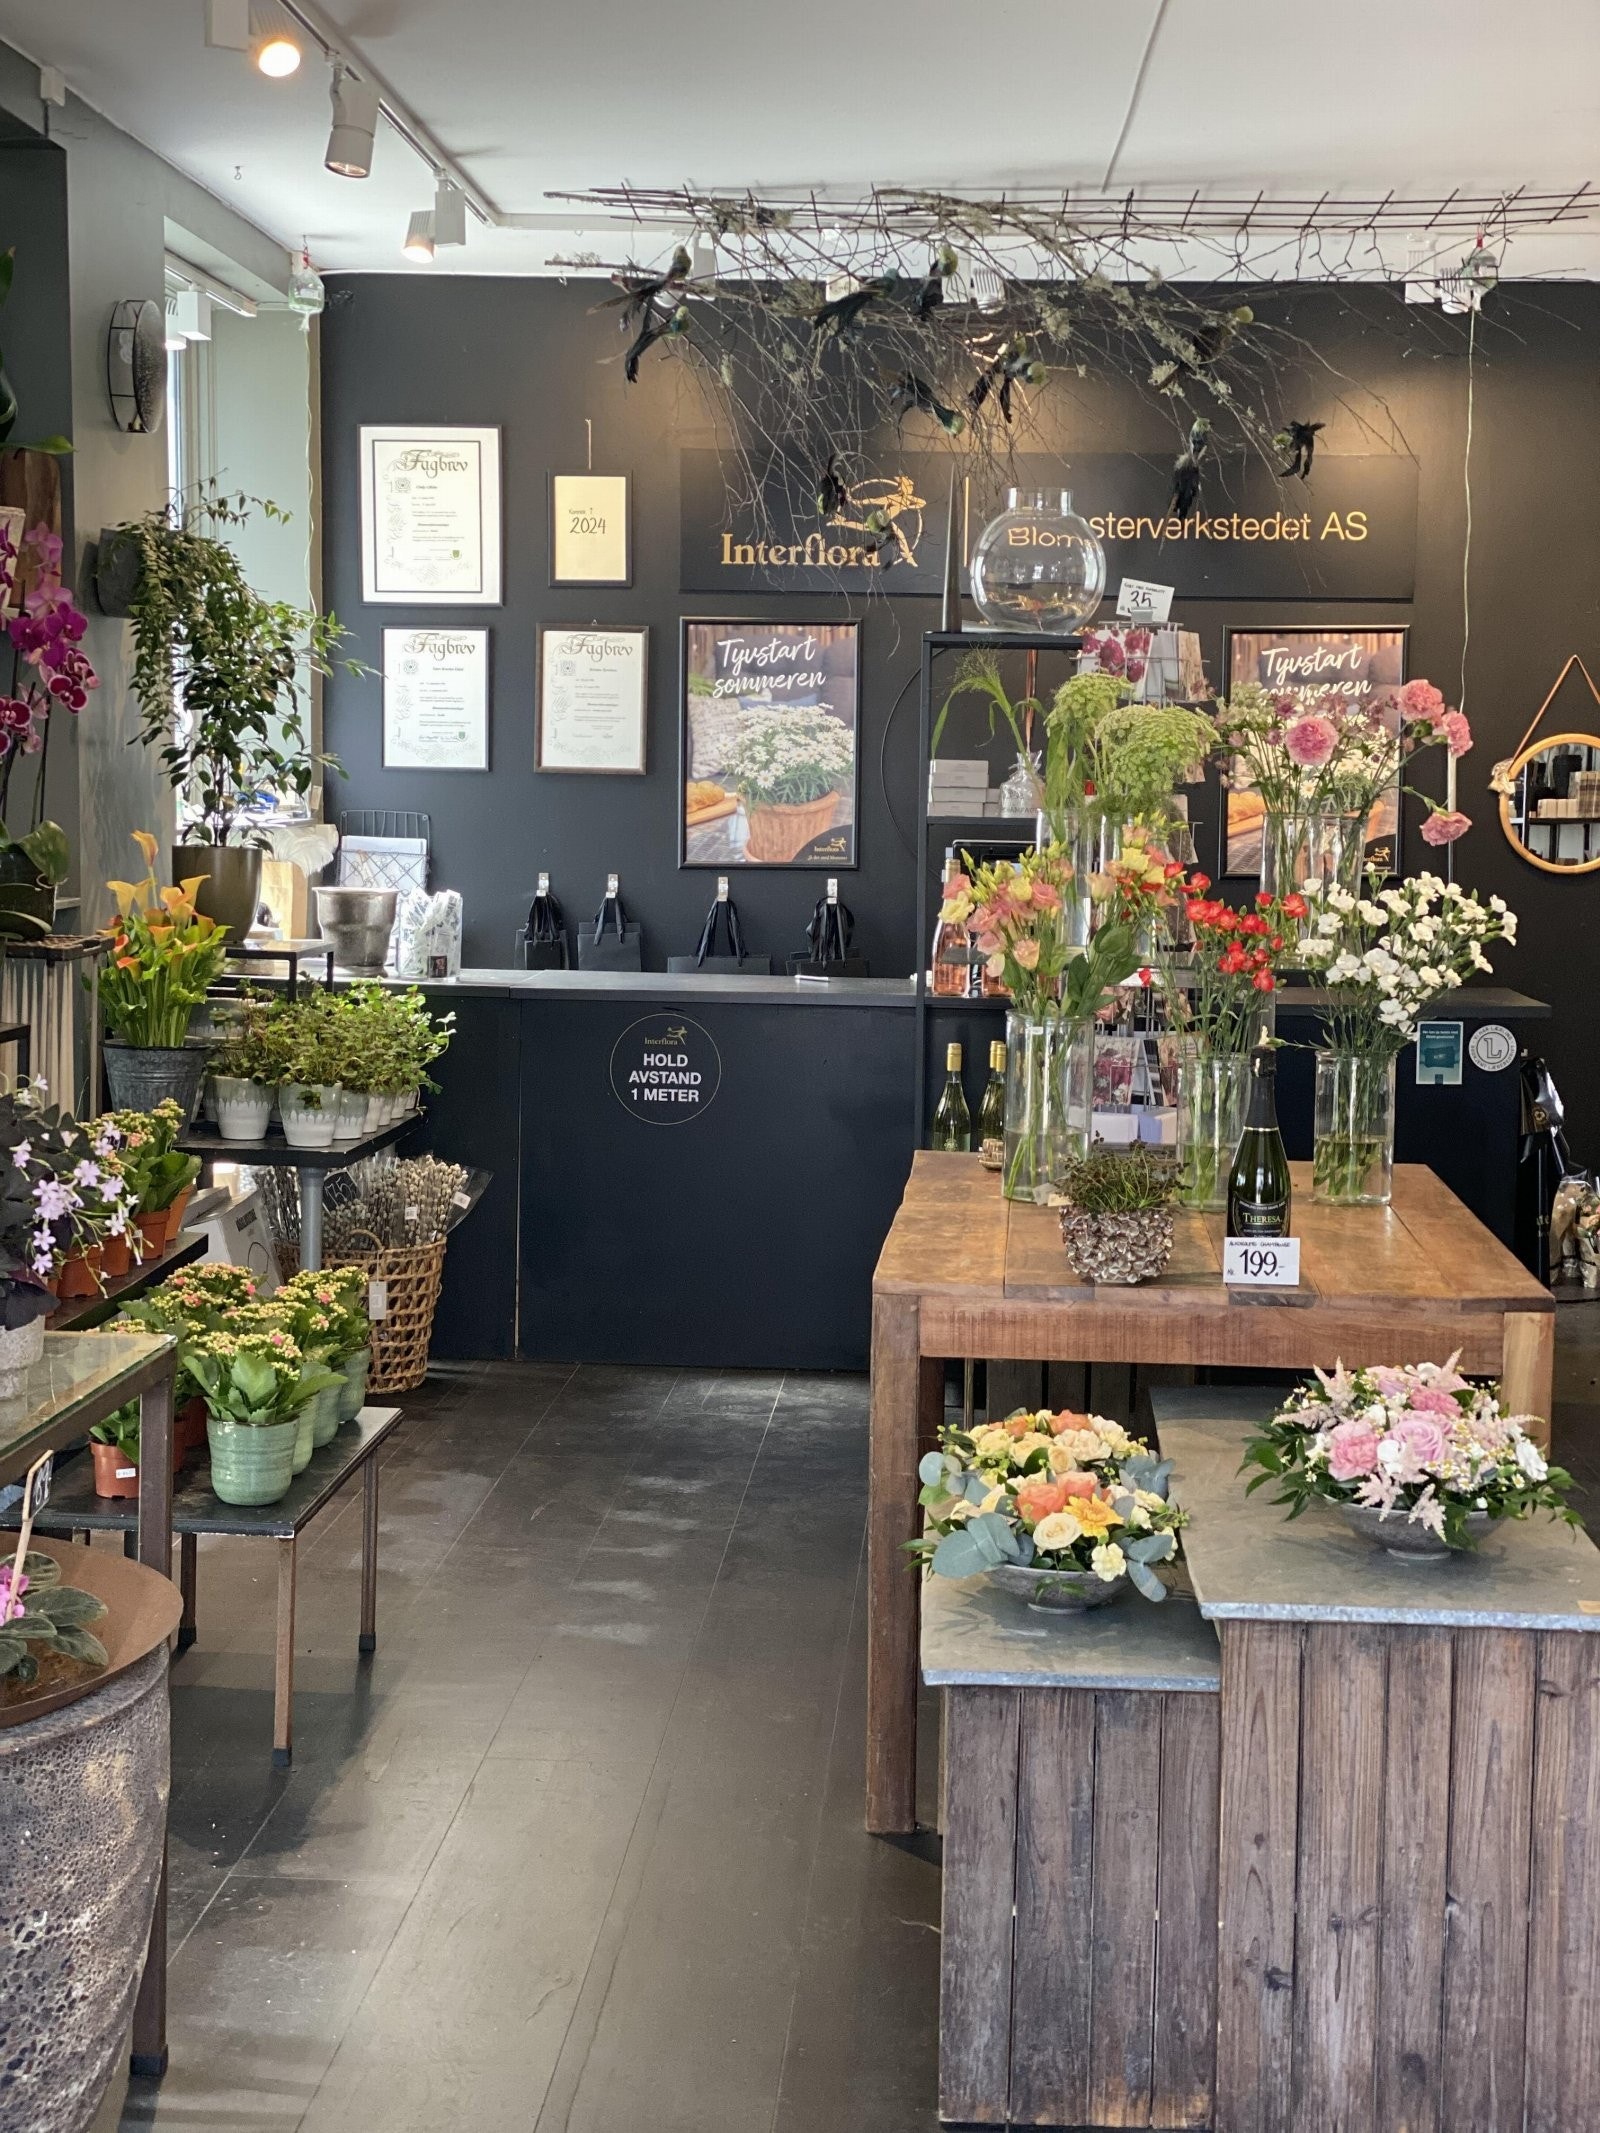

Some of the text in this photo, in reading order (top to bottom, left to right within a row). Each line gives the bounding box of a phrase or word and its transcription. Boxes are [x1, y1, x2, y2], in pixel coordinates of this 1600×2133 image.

[396, 449, 468, 479] Fagbrev
[569, 516, 608, 535] 2024
[1320, 511, 1368, 541] AS
[720, 533, 881, 567] Interflora
[403, 633, 476, 662] Fagbrev
[560, 634, 633, 663] Fagbrev
[716, 635, 817, 676] Tyvstart
[1261, 643, 1364, 685] Tyvstart
[712, 671, 827, 699] sommeren
[644, 1037, 678, 1046] Interflora
[1483, 1037, 1503, 1059] L
[643, 1053, 689, 1067] HOLD
[628, 1070, 702, 1085] AVSTAND
[631, 1088, 699, 1102] 1 METER
